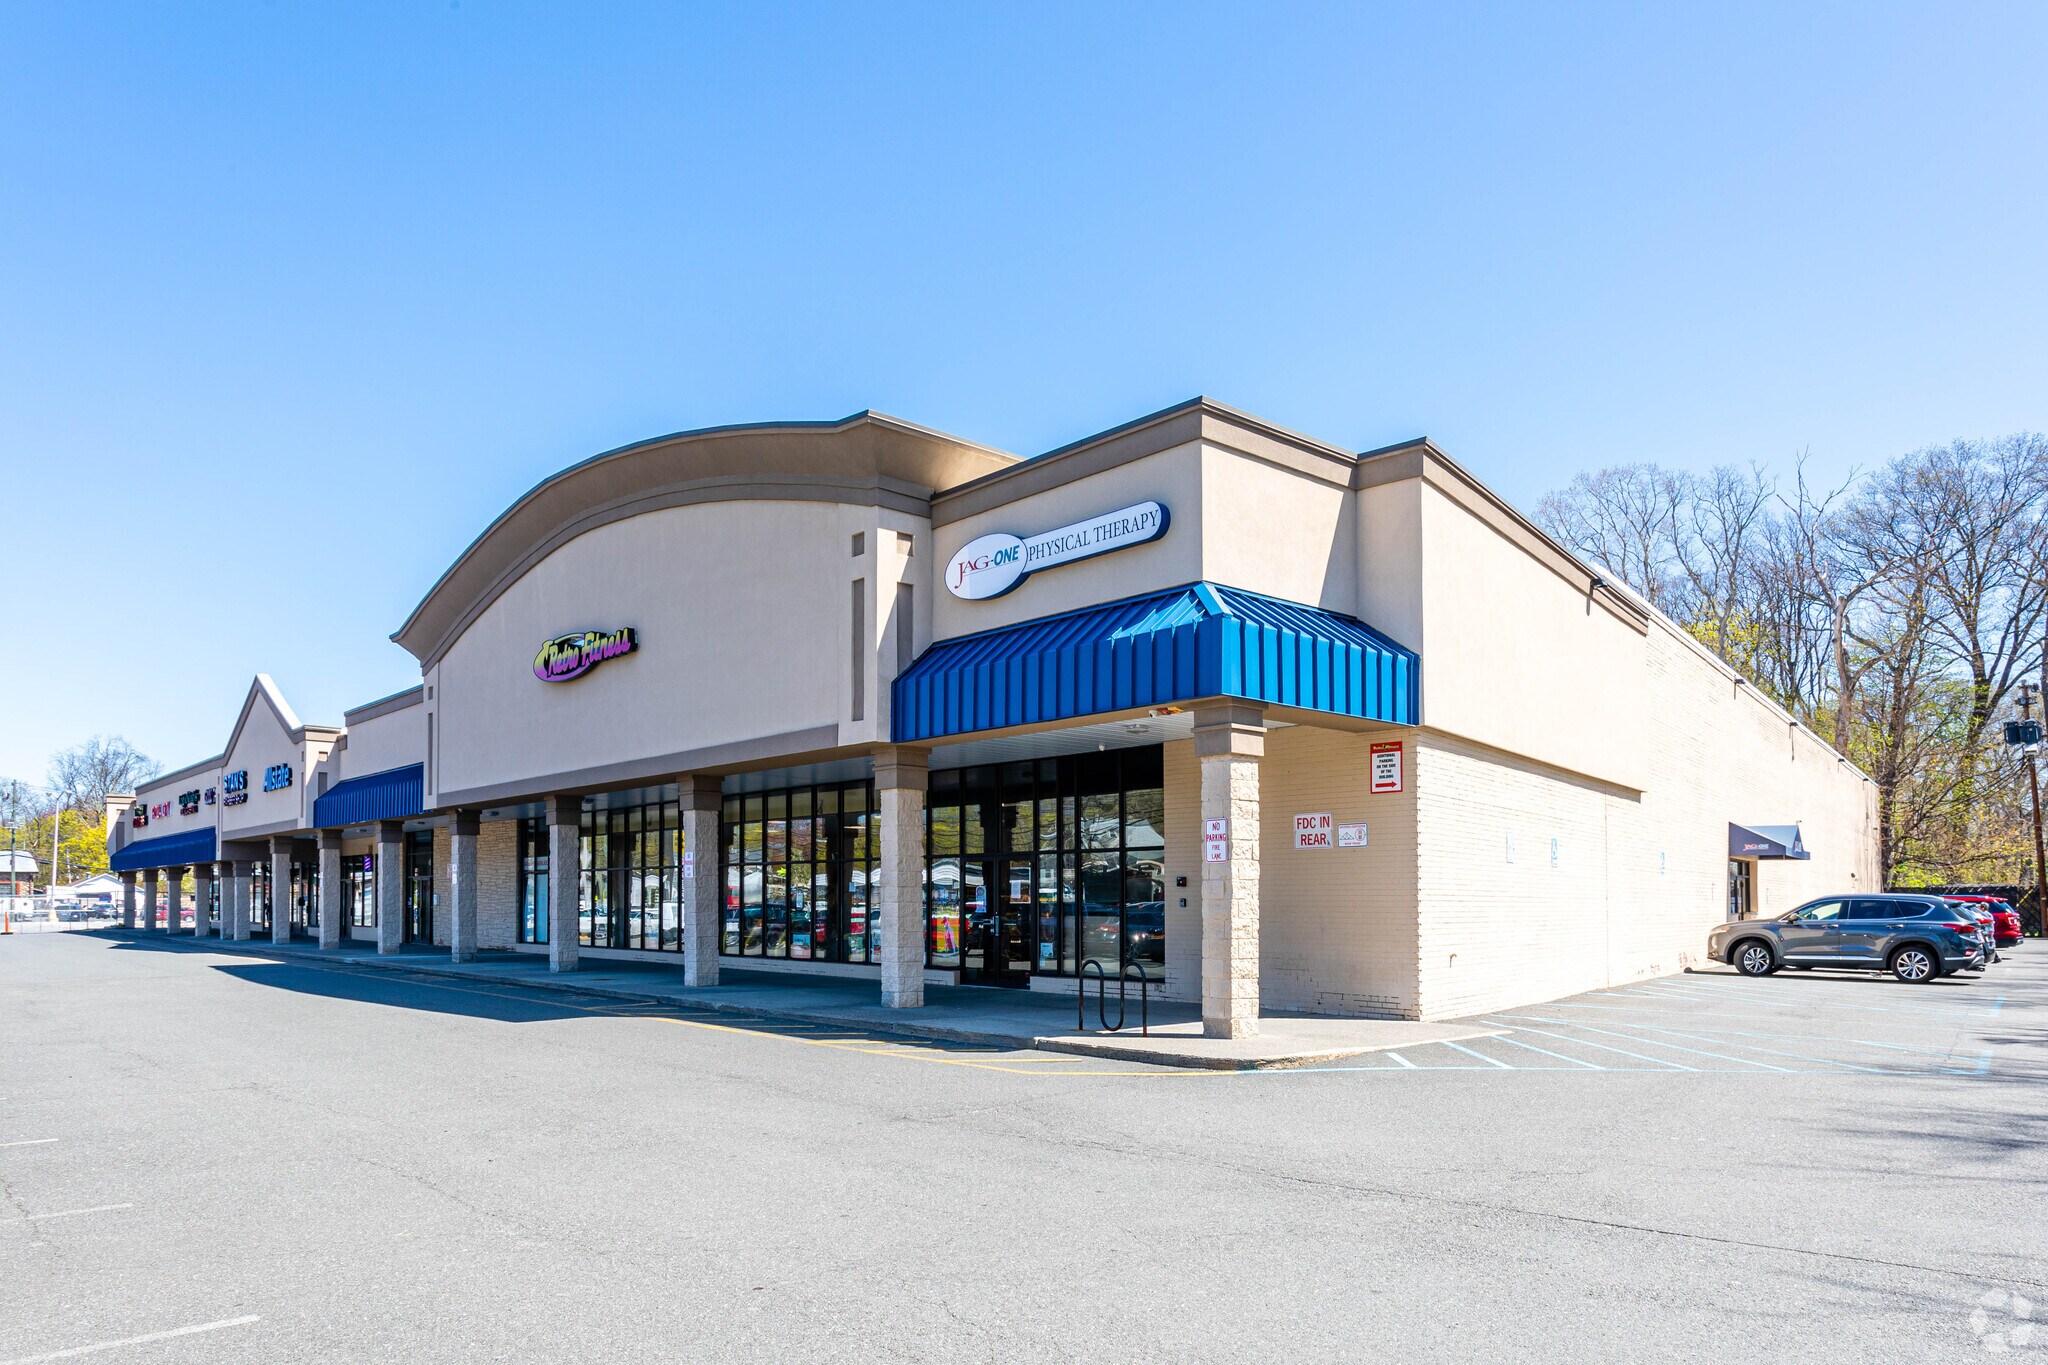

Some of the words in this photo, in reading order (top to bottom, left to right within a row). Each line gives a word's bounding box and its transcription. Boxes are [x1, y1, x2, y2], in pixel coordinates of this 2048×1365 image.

[954, 544, 1020, 589] JAG-ONE
[1028, 533, 1090, 562] PHYSICAL
[1093, 509, 1159, 542] THERAPY
[547, 644, 579, 677] Retro
[580, 627, 631, 667] Fitness
[262, 763, 290, 792] Allstate
[1212, 822, 1221, 831] NO
[1296, 817, 1316, 830] FDC
[1320, 816, 1330, 828] IN
[1206, 833, 1227, 842] PARKING
[1300, 833, 1327, 846] REAR
